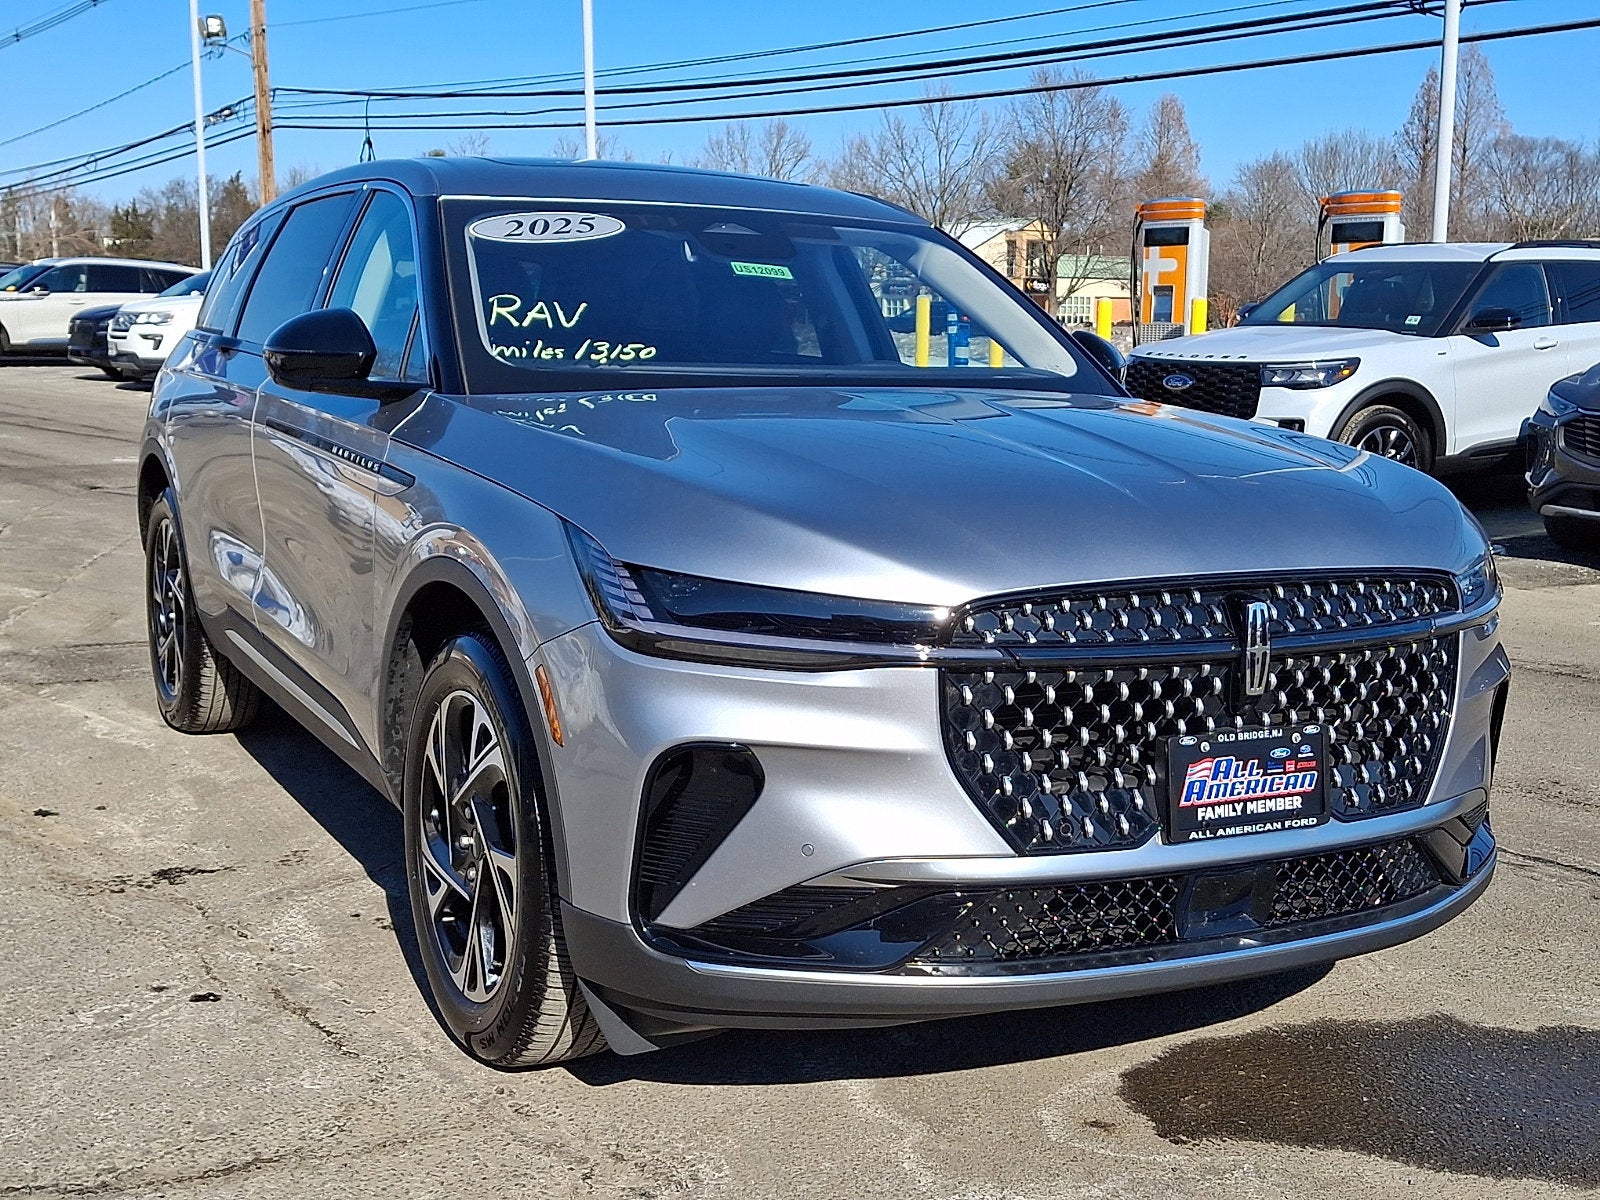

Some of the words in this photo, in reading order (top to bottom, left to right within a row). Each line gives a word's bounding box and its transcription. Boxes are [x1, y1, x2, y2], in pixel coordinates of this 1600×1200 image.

[503, 215, 597, 238] 2025
[733, 264, 786, 278] US12099
[488, 293, 588, 329] RAV
[492, 338, 565, 359] miles
[331, 446, 379, 472] NAUTILUS
[1217, 733, 1236, 743] OLD
[1210, 756, 1263, 781] ALL
[1183, 772, 1317, 803] AMERICAN
[1197, 800, 1245, 821] FAMILY
[1246, 796, 1303, 815] MEMBER
[1188, 829, 1214, 840] ALL
[1216, 822, 1282, 837] AMERICAN
[1284, 817, 1318, 828] FORD
